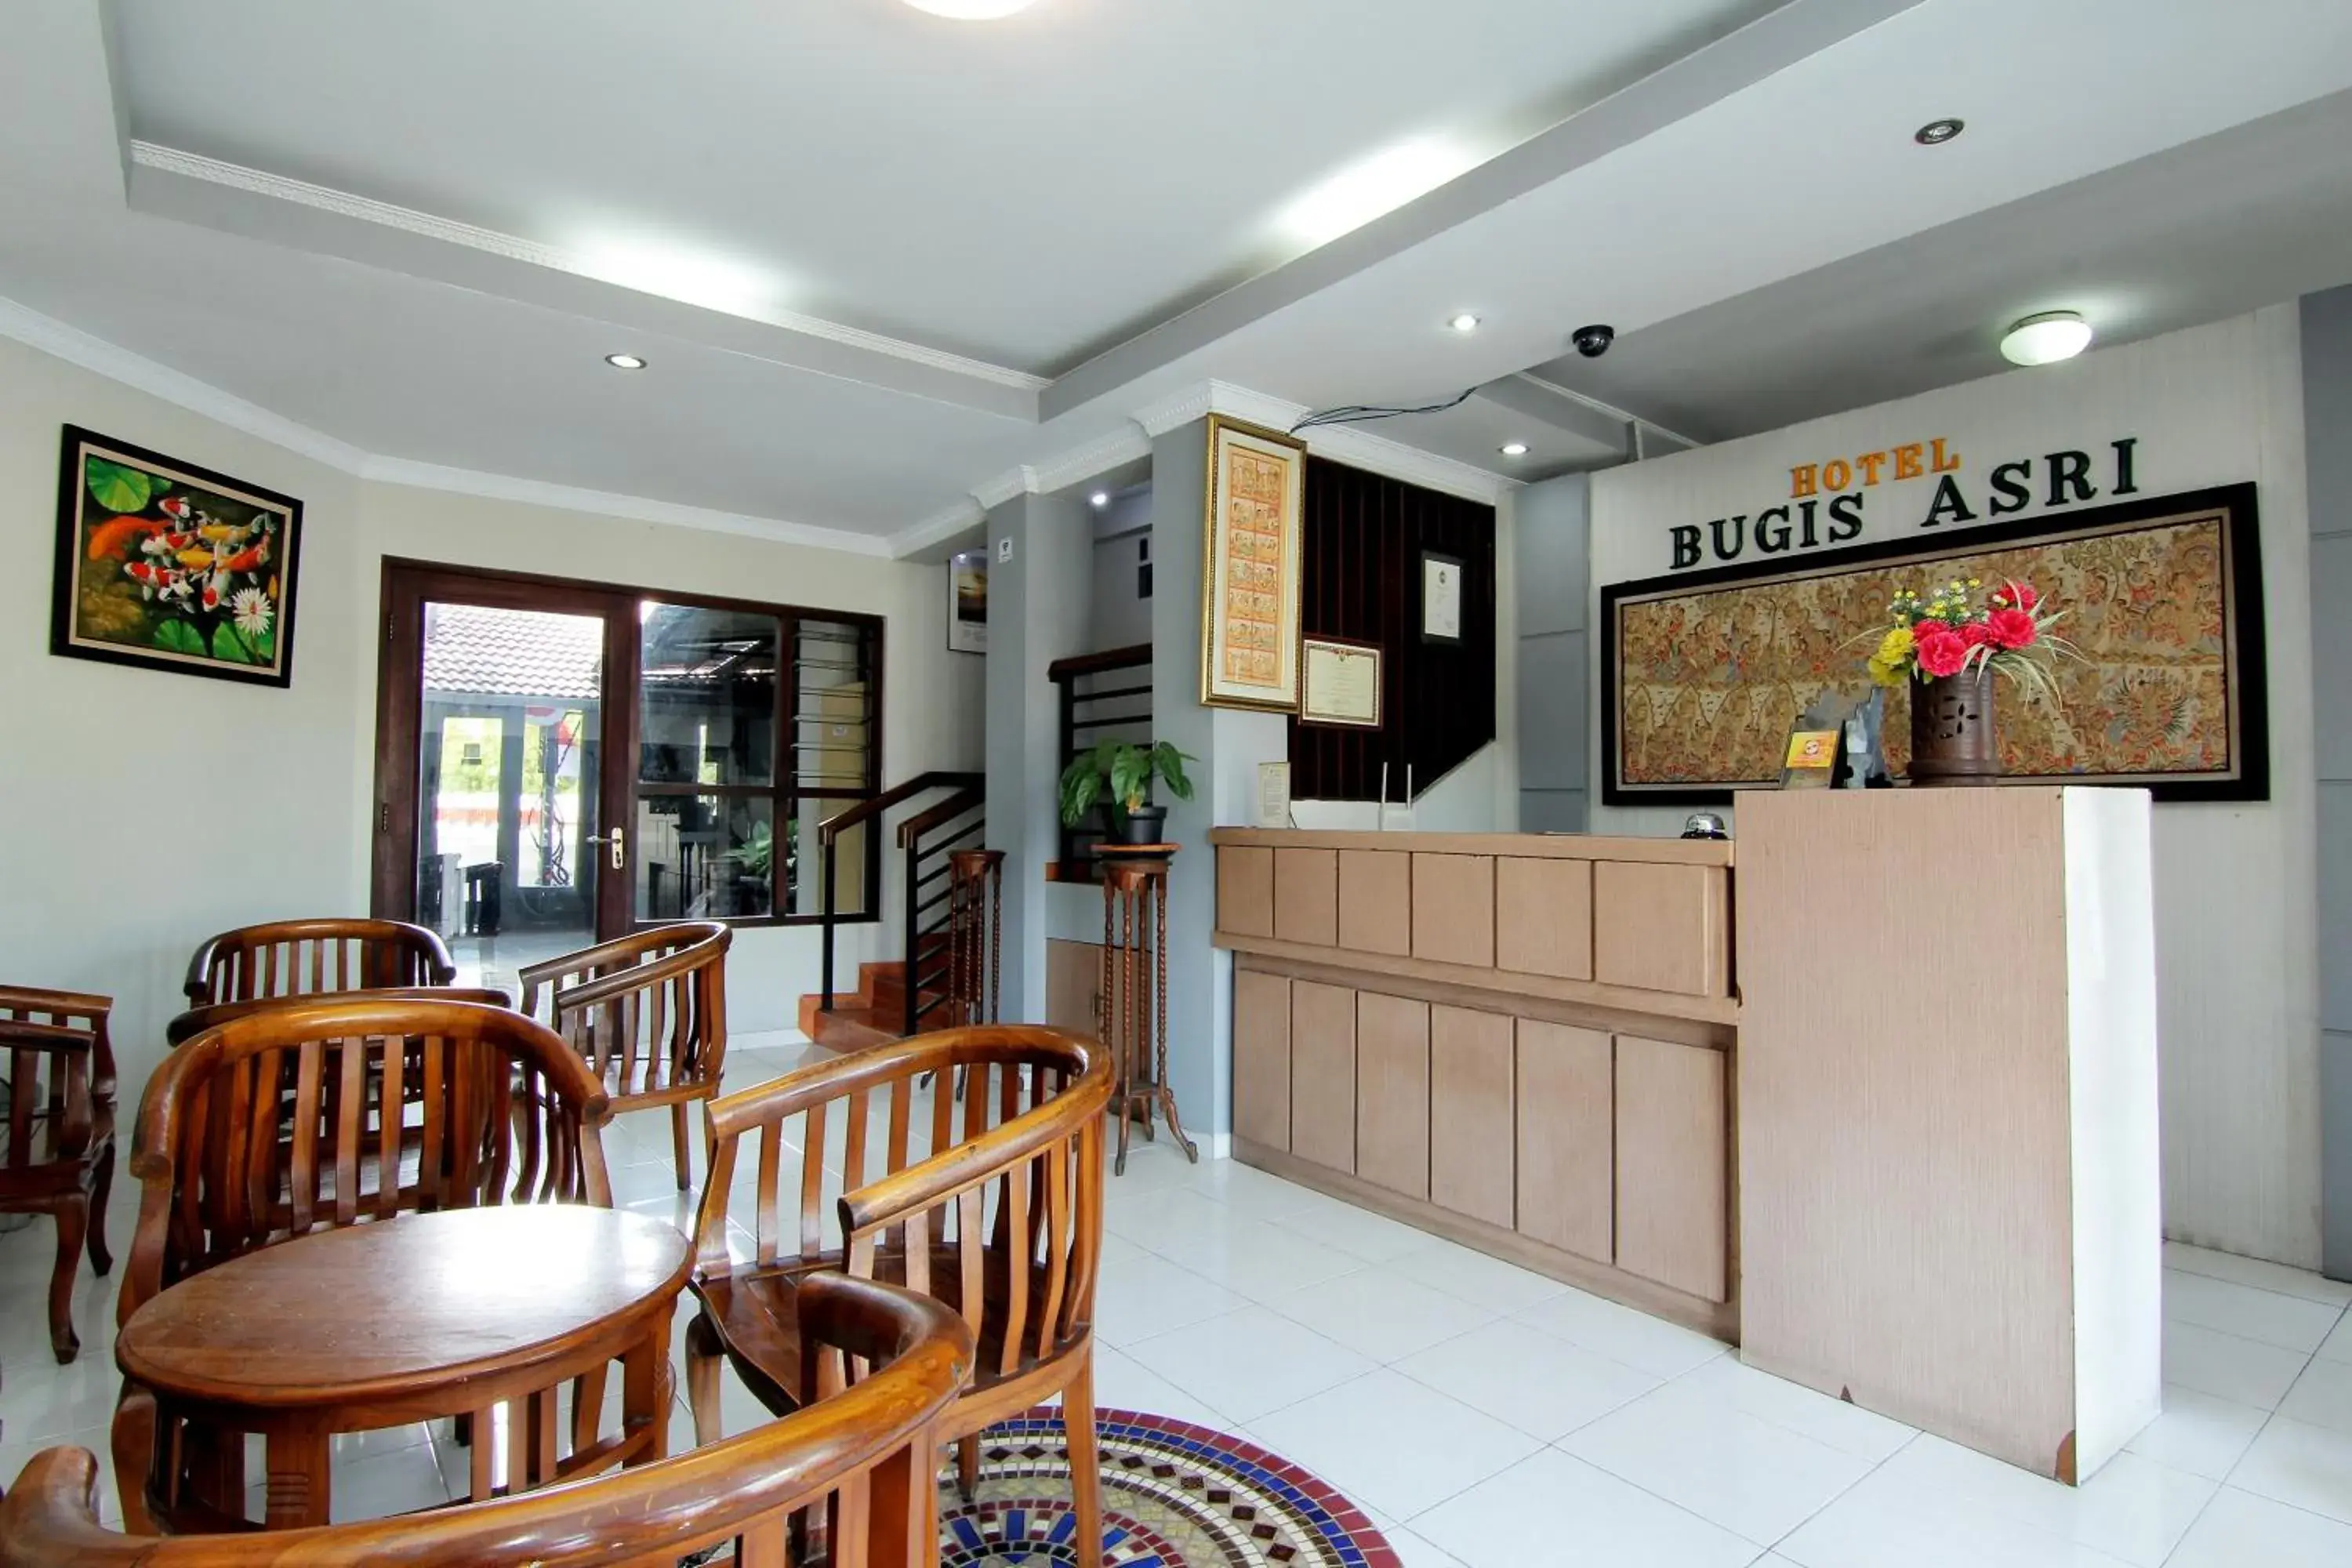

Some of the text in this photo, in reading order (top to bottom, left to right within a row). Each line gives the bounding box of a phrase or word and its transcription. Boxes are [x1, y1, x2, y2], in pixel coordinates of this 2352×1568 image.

[1668, 437, 2138, 570] BUGIS ASRI
[1790, 437, 1960, 498] HOTEL
